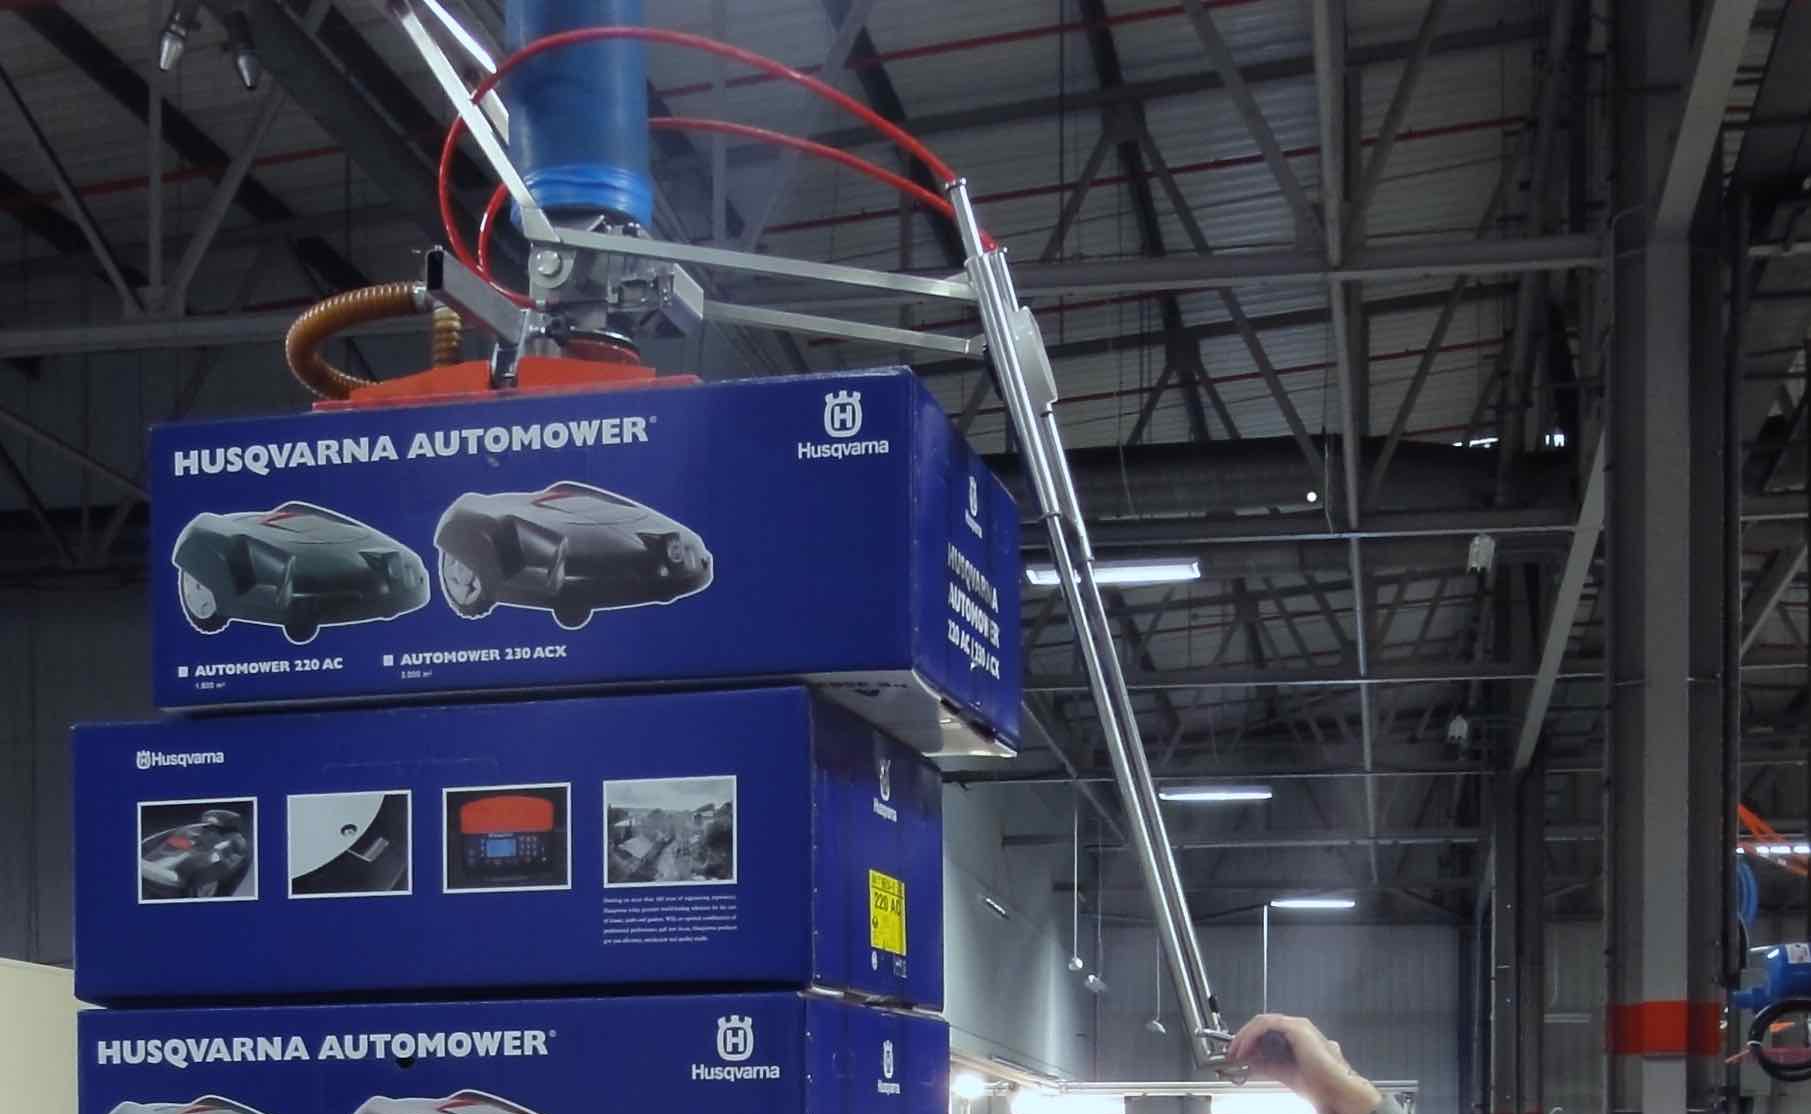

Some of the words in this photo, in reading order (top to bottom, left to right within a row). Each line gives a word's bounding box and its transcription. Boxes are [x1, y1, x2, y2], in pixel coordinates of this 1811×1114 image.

[174, 435, 398, 476] HUSQVARNA
[798, 440, 889, 459] Husqvarna
[400, 648, 500, 666] AUTOMOWER
[505, 647, 531, 660] 230
[533, 645, 567, 659] ACX
[195, 660, 290, 677] AUTOMOWER
[294, 658, 320, 671] 220
[322, 657, 343, 670] AC
[152, 751, 224, 767] Husqvarna
[98, 1036, 310, 1068] HUSQVARNA
[691, 1064, 780, 1082] Husqvarna
